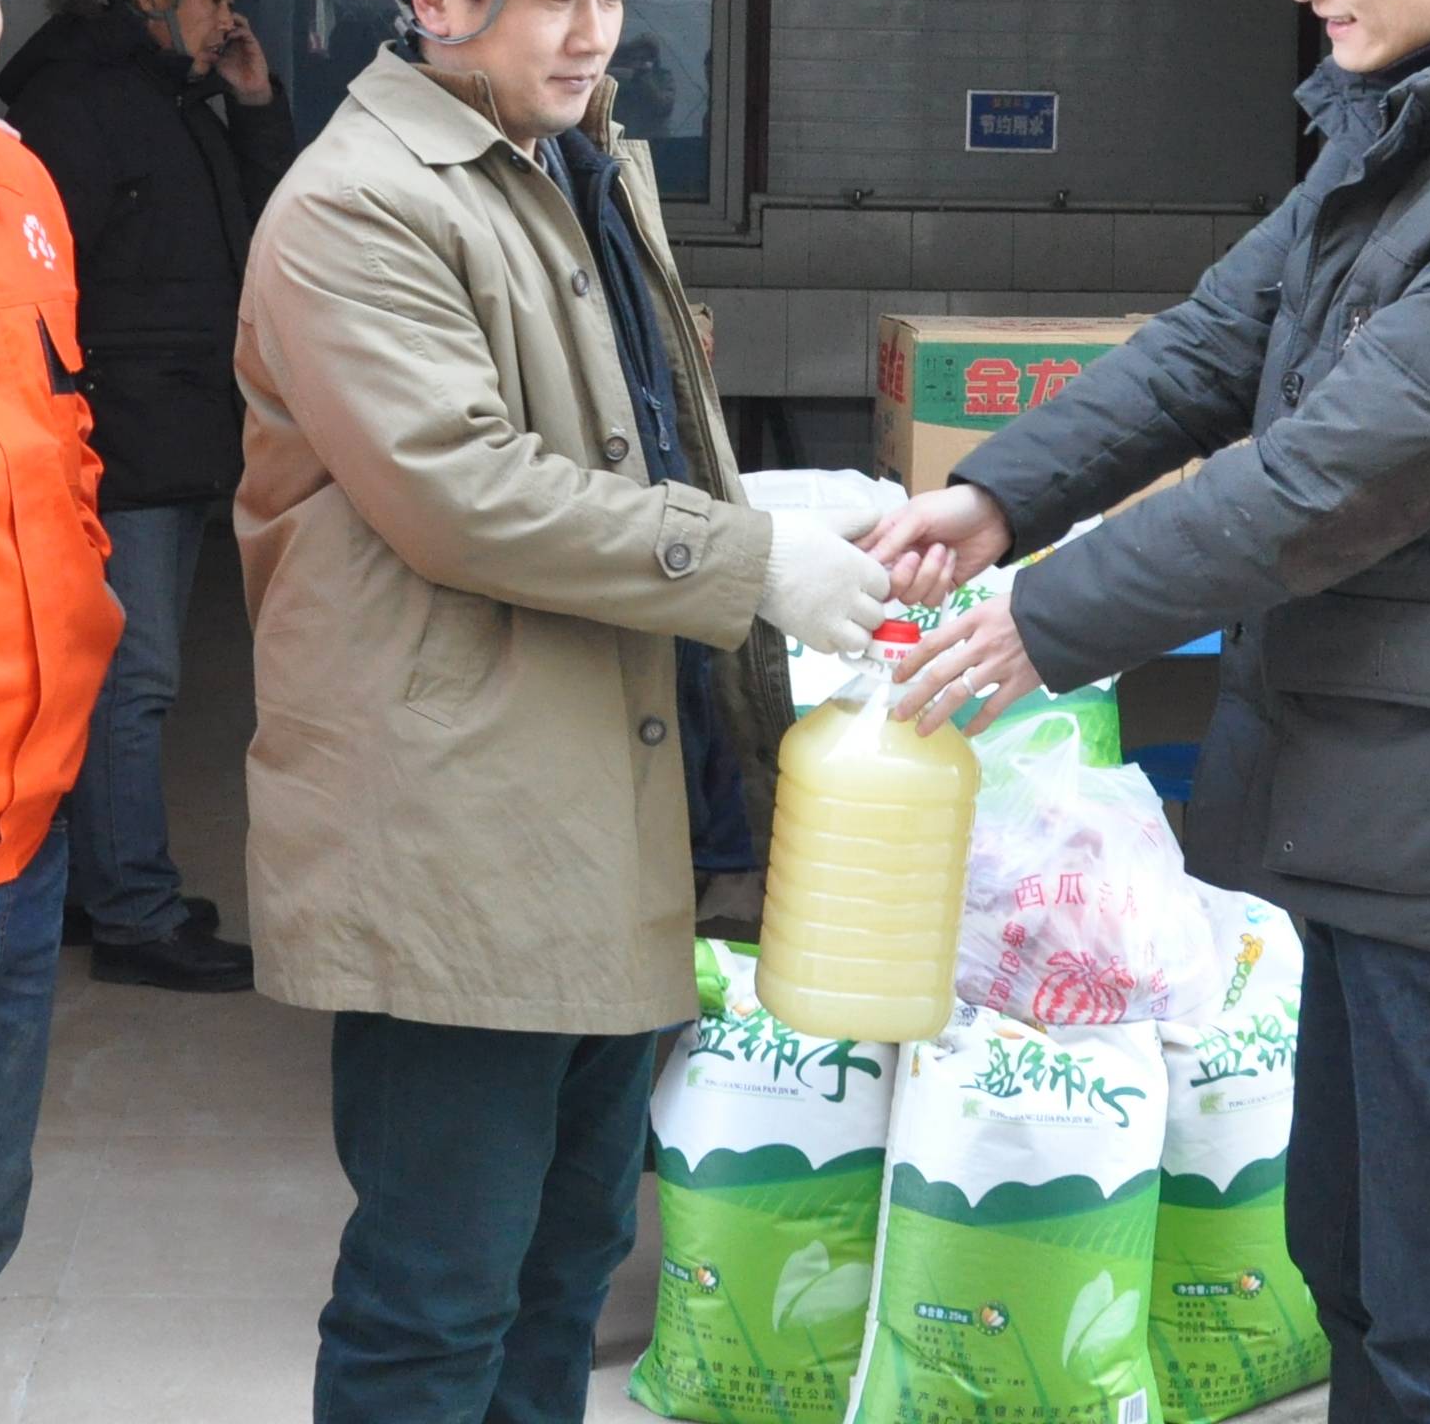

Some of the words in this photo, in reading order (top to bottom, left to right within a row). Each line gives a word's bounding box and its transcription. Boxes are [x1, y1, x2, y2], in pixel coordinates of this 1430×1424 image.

[980, 114, 1044, 136] 节约用水
[883, 646, 912, 661] 金龙
